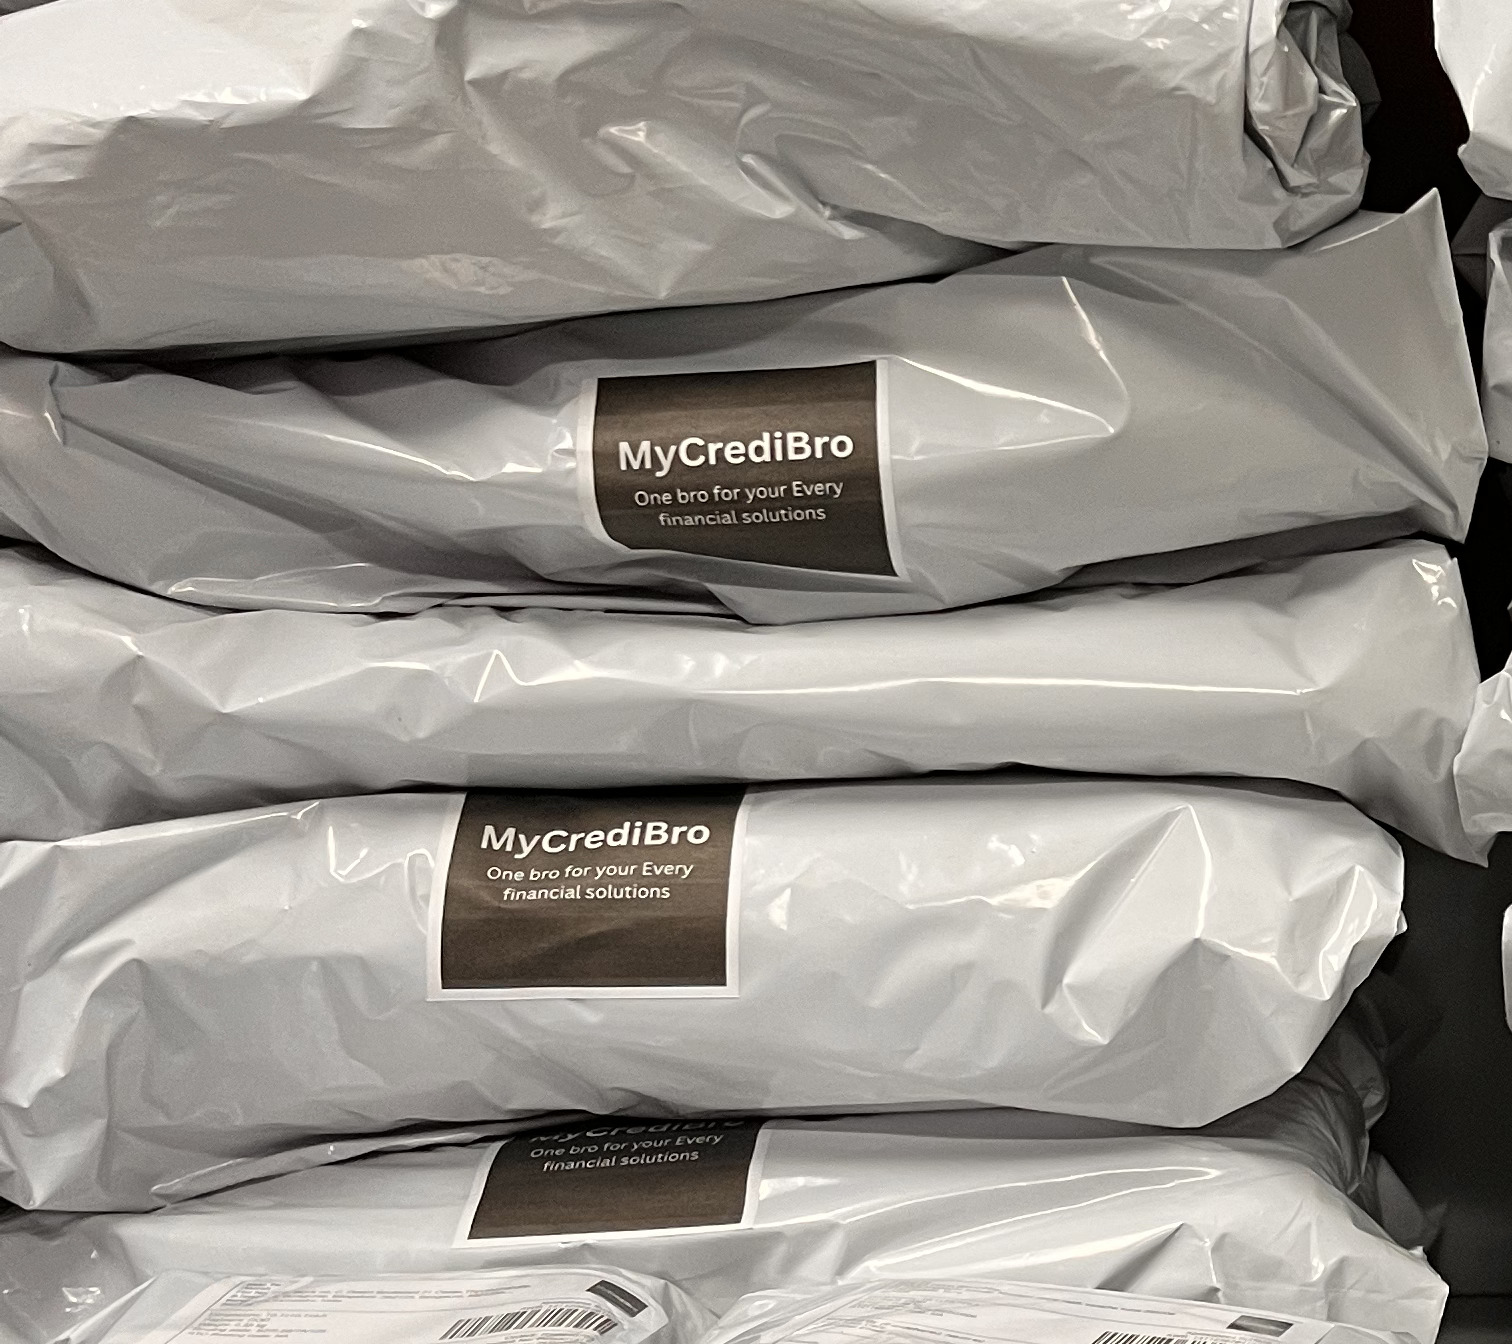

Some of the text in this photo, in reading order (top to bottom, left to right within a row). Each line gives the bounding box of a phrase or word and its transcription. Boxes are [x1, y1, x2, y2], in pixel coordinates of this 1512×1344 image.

[618, 430, 855, 478] MyCrediBro
[634, 480, 845, 507] One bro for your Every
[658, 506, 827, 527] financial solutions
[479, 820, 711, 859] MyCrediBro
[486, 860, 695, 882] One bro for your Every
[502, 883, 671, 902] financial solutions
[529, 1133, 725, 1159] One bro for your Every
[542, 1149, 700, 1173] financial solutions
